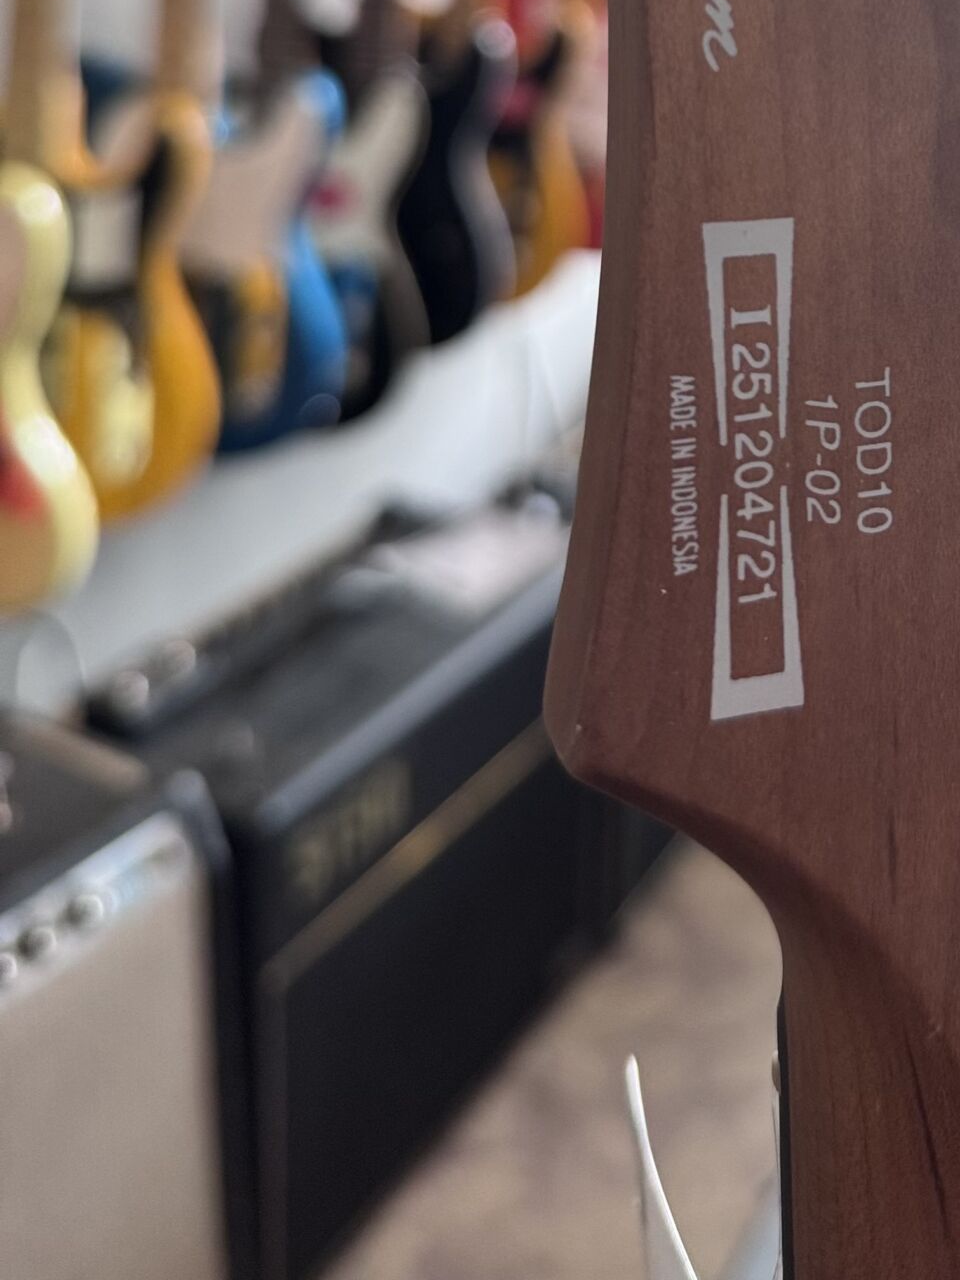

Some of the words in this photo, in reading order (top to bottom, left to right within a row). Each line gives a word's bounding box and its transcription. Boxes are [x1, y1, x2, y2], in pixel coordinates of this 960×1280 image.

[669, 373, 696, 431] MADE
[672, 436, 697, 460] IN
[854, 366, 893, 534] TOD10
[803, 394, 841, 525] 1P-02
[671, 465, 698, 577] INDONESIA
